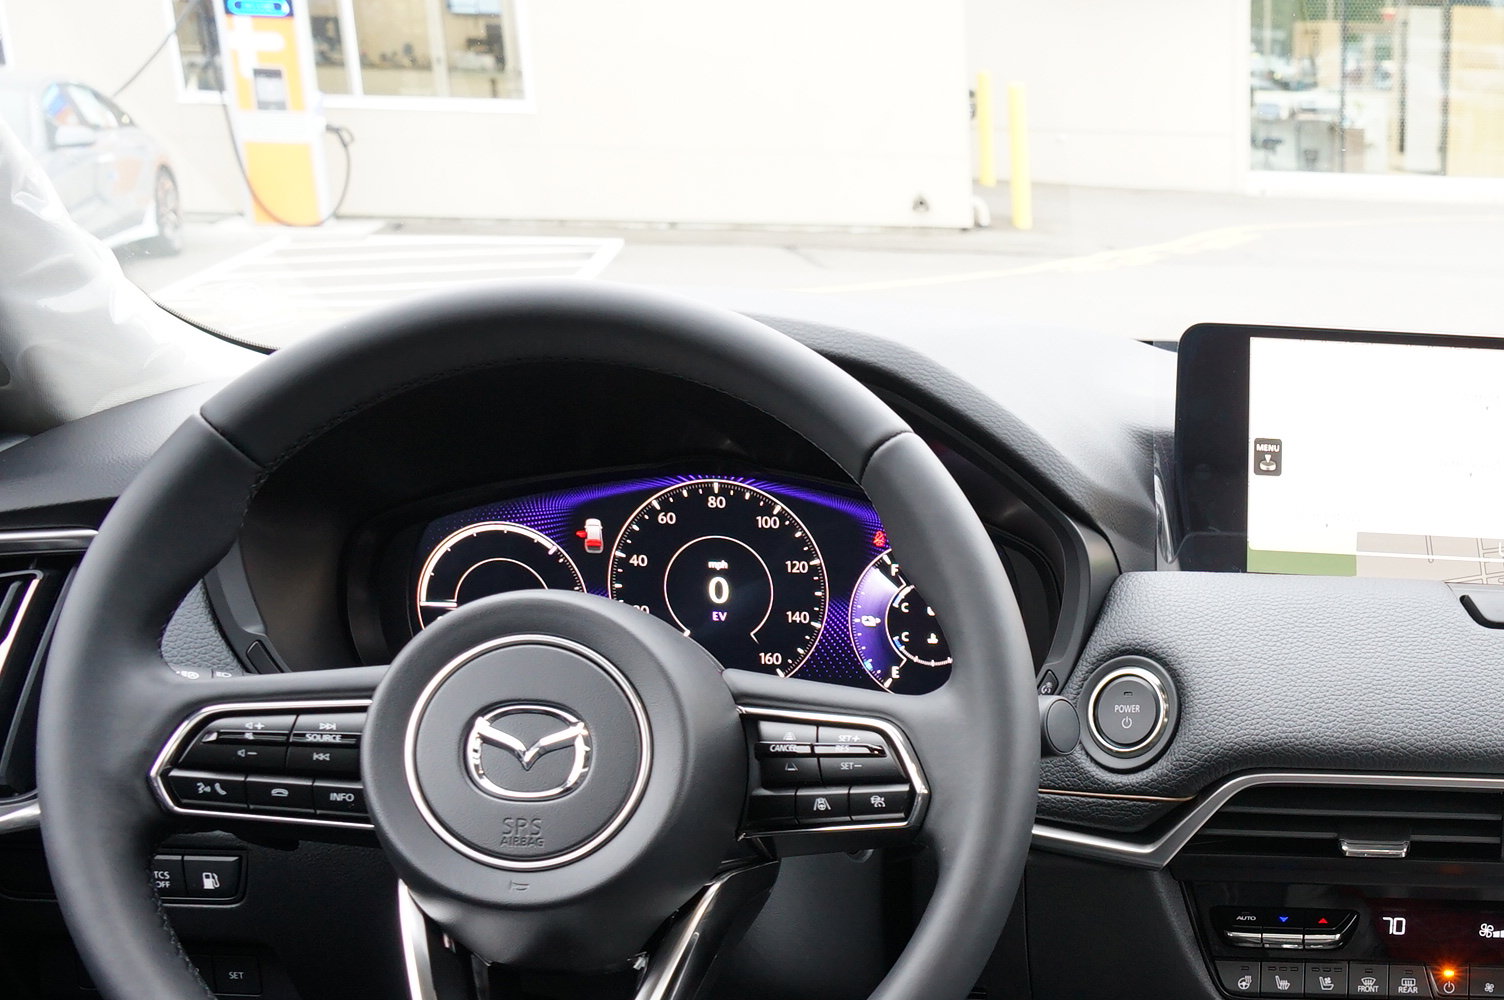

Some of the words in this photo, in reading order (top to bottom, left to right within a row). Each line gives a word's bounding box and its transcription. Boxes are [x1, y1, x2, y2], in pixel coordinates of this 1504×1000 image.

[1256, 444, 1280, 452] MENU
[707, 496, 726, 509] 80
[657, 512, 677, 525] 60
[756, 516, 780, 529] 100
[629, 554, 648, 567] 40
[708, 560, 729, 570] mph
[785, 560, 809, 574] 120
[891, 564, 900, 576] F
[708, 576, 730, 604] 0
[900, 602, 910, 613] C
[712, 612, 728, 622] EV
[786, 611, 810, 624] 140
[901, 632, 910, 642] C
[758, 652, 782, 665] 160
[892, 666, 900, 679] E
[1114, 704, 1140, 713] POWER
[305, 733, 342, 742] SOURCE
[330, 792, 355, 802] INFO
[500, 836, 545, 848] AIRBAG
[153, 870, 170, 880] TCS
[1382, 916, 1406, 936] 70
[228, 972, 244, 980] SET
[1357, 985, 1379, 993] FRONT
[1398, 986, 1418, 994] REAR
